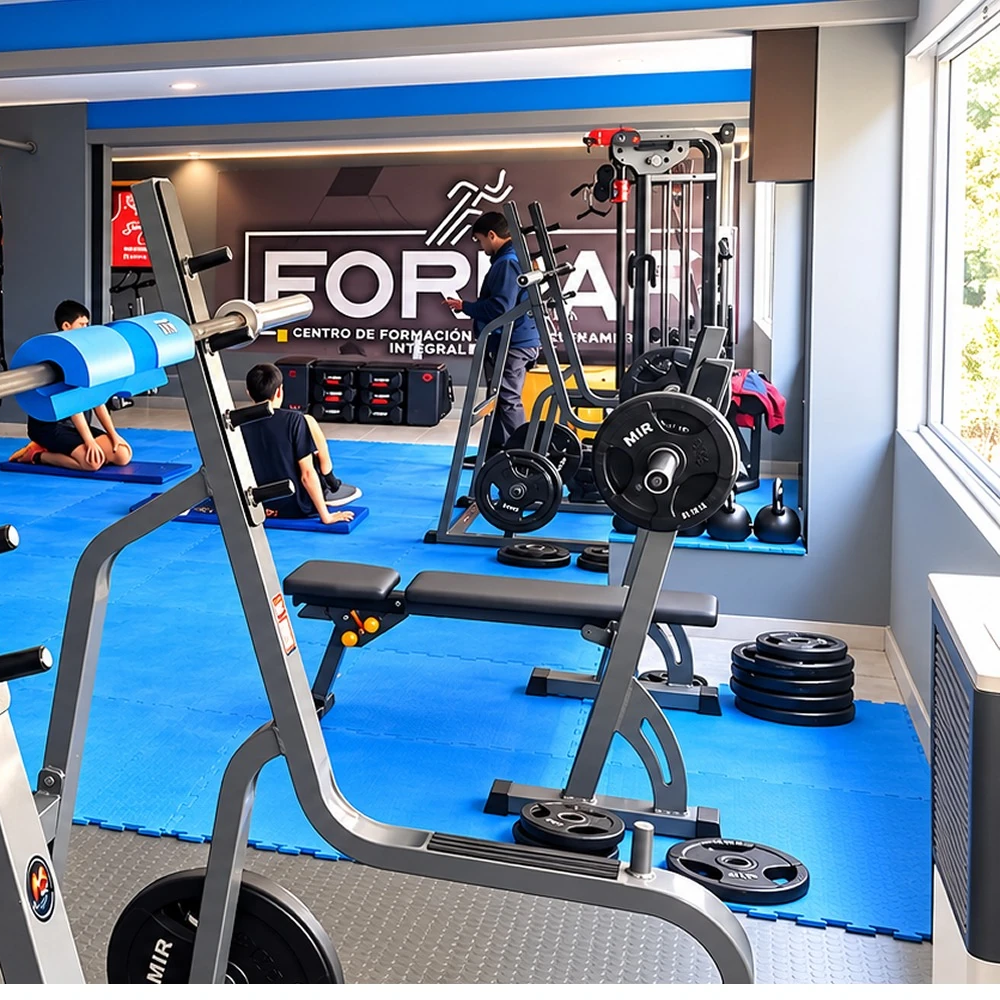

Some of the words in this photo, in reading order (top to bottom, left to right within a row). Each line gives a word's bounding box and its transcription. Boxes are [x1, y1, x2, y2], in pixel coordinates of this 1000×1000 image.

[264, 250, 706, 321] FORAR
[292, 327, 351, 339] CENTRO
[355, 328, 375, 340] DE
[379, 327, 472, 341] FORMACIÓN
[389, 342, 467, 355] INTEGRAL
[622, 421, 654, 448] MIR
[146, 938, 174, 984] MIR
